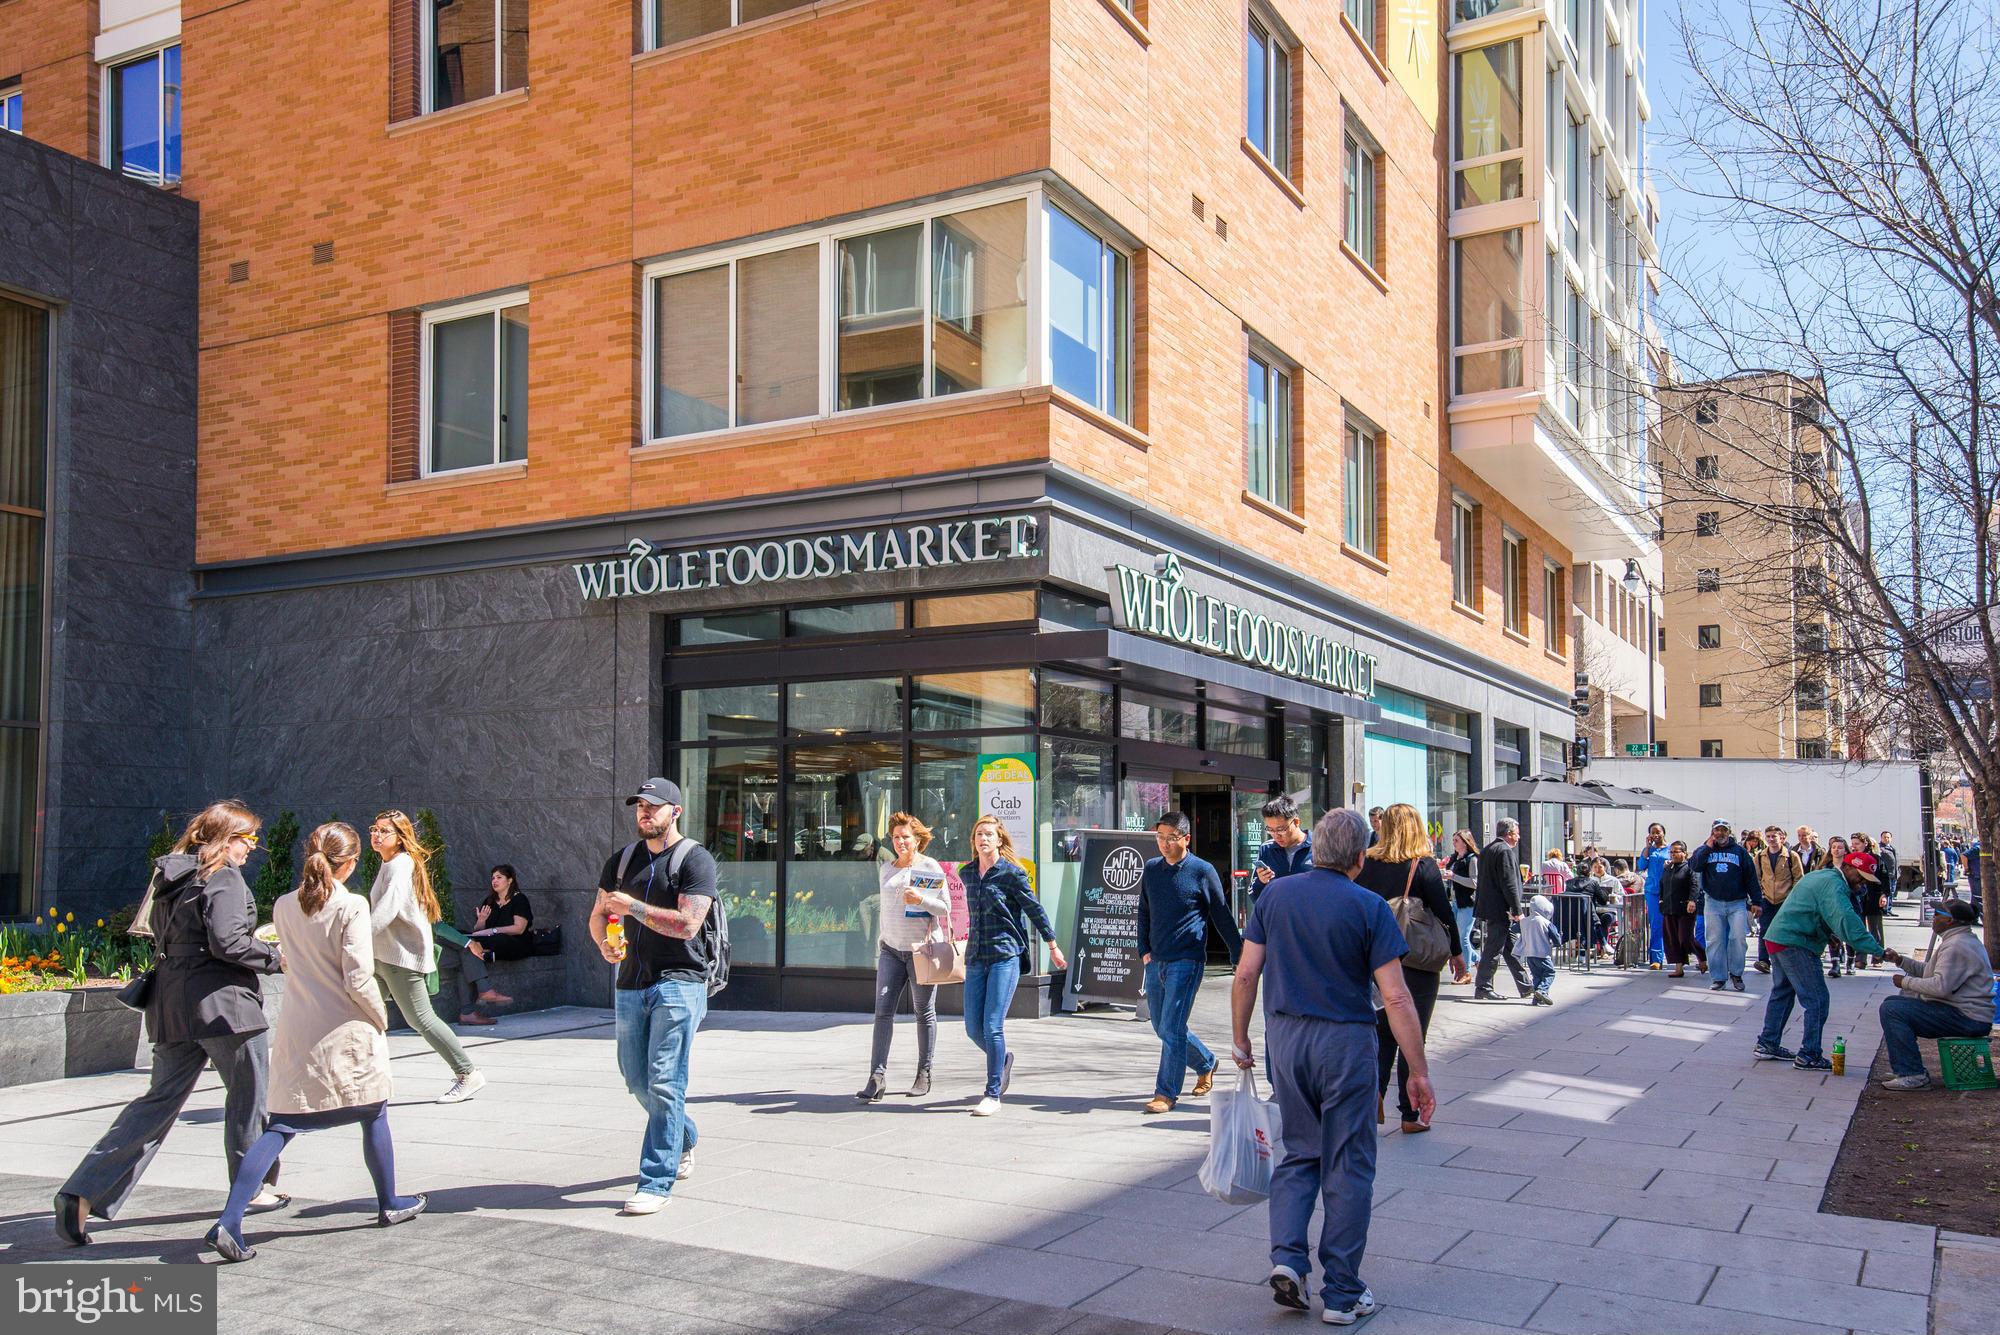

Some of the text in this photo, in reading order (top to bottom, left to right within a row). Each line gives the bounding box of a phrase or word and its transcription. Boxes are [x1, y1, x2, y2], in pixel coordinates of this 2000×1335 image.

[573, 514, 1041, 600] WHOLE FOODS MARKET
[1115, 553, 1378, 698] WHOLE FOODS MARKET
[986, 770, 1029, 780] BIG DEAL
[990, 796, 1022, 809] Crab
[1124, 813, 1145, 828] WHOLE
[1247, 819, 1262, 832] WHOLE
[1112, 850, 1138, 870] WFM
[1104, 868, 1138, 888] FOODIE
[1106, 904, 1132, 914] EATERS
[1105, 938, 1137, 948] FEATURIN
